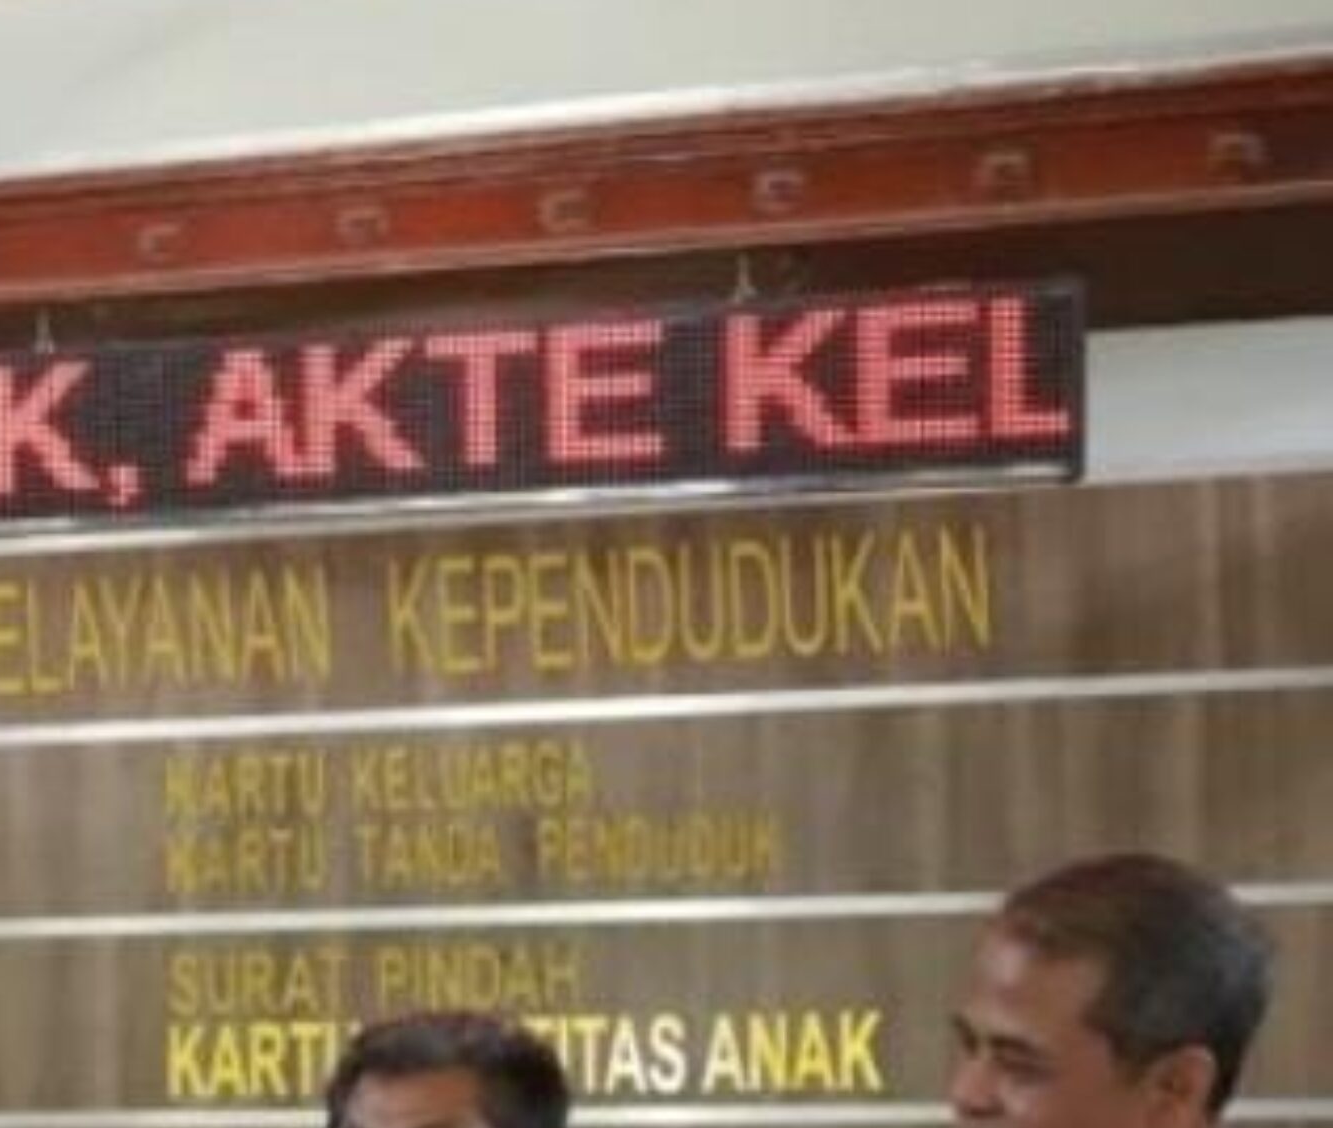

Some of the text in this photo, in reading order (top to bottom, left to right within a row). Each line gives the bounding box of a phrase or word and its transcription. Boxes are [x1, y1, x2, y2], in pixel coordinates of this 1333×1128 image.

[185, 322, 664, 488] AKTE
[721, 298, 1071, 452] KEL
[389, 523, 991, 676] KEPENDUDUKAN
[165, 741, 591, 818] KARTU KELUARGA
[165, 810, 775, 894] KARTU TANDA PENDUDUK
[169, 938, 579, 1016] SURAT PINDAH
[701, 1008, 884, 1093] ANAK
